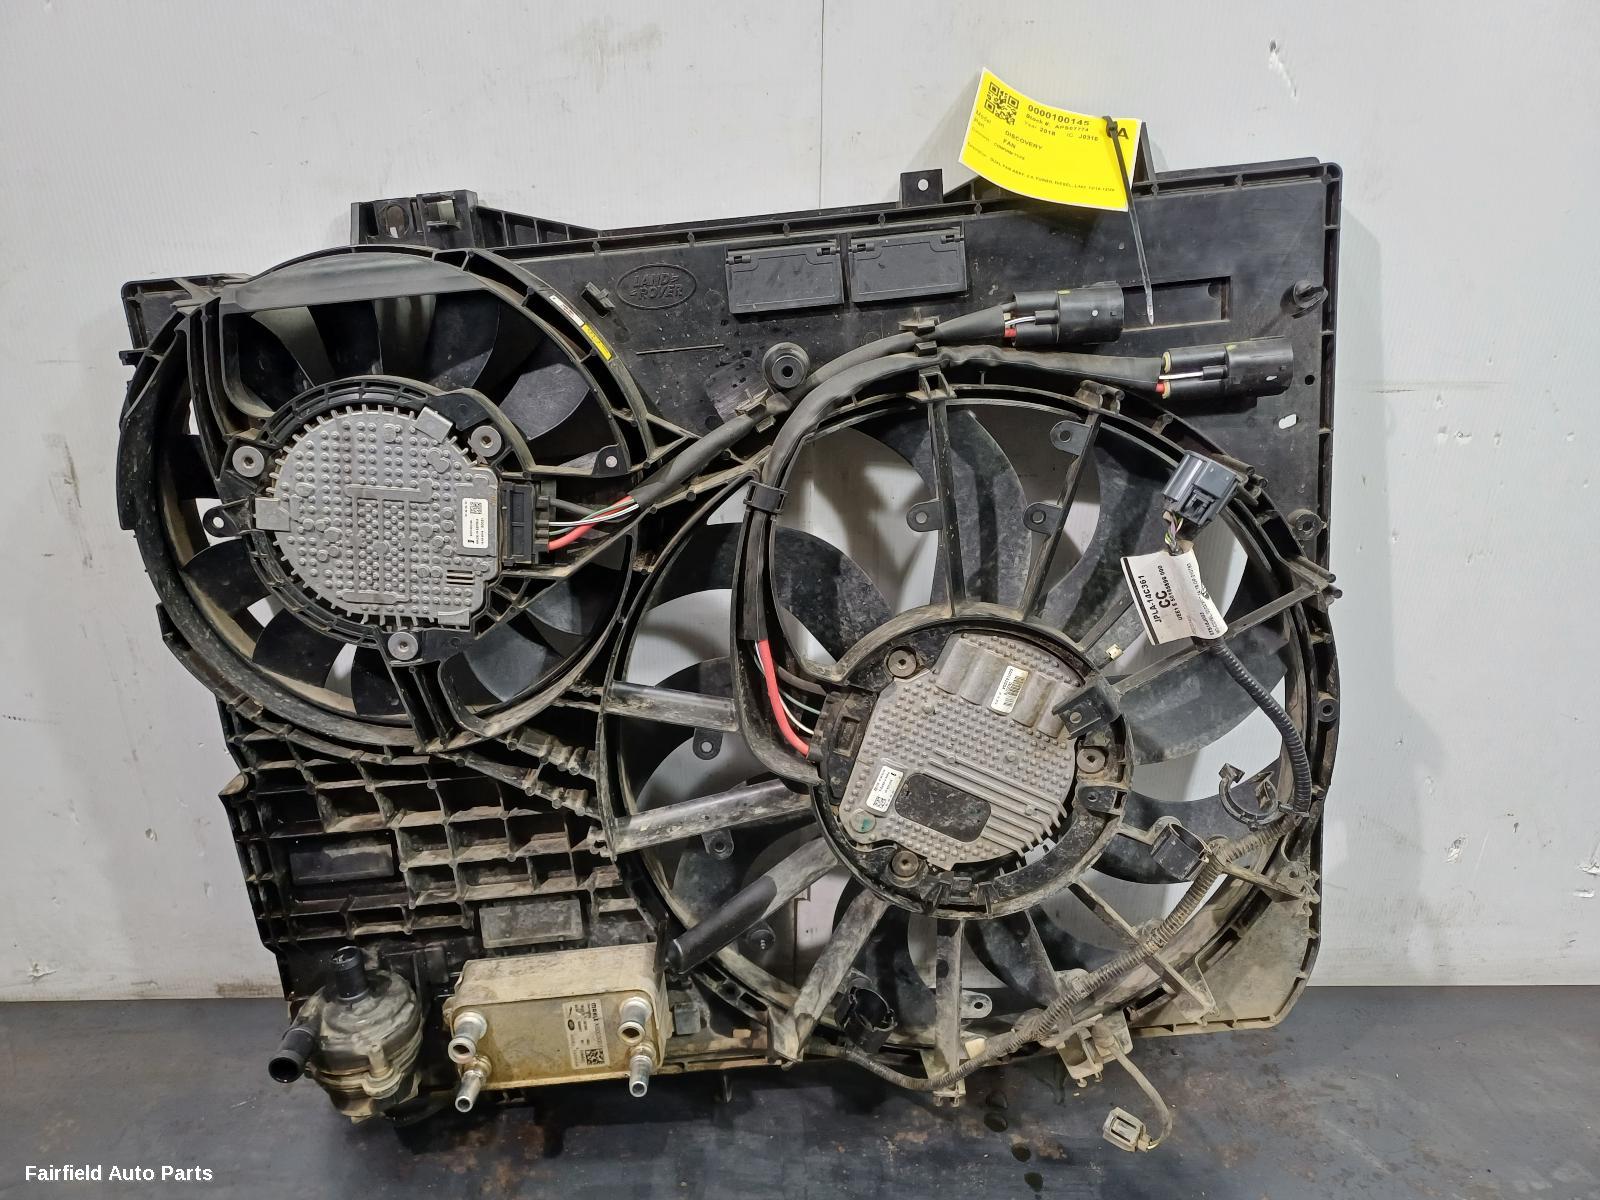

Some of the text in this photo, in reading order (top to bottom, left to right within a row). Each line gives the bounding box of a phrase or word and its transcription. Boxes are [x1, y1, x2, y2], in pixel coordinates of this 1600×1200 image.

[1027, 104, 1090, 126] 0000100145
[1002, 139, 1017, 149] FAN
[1004, 130, 1044, 150] DISCOVERY
[633, 272, 669, 287] LAND
[639, 284, 683, 300] ROVER
[1138, 575, 1162, 623] JPLA-14C361
[1155, 590, 1171, 608] CC
